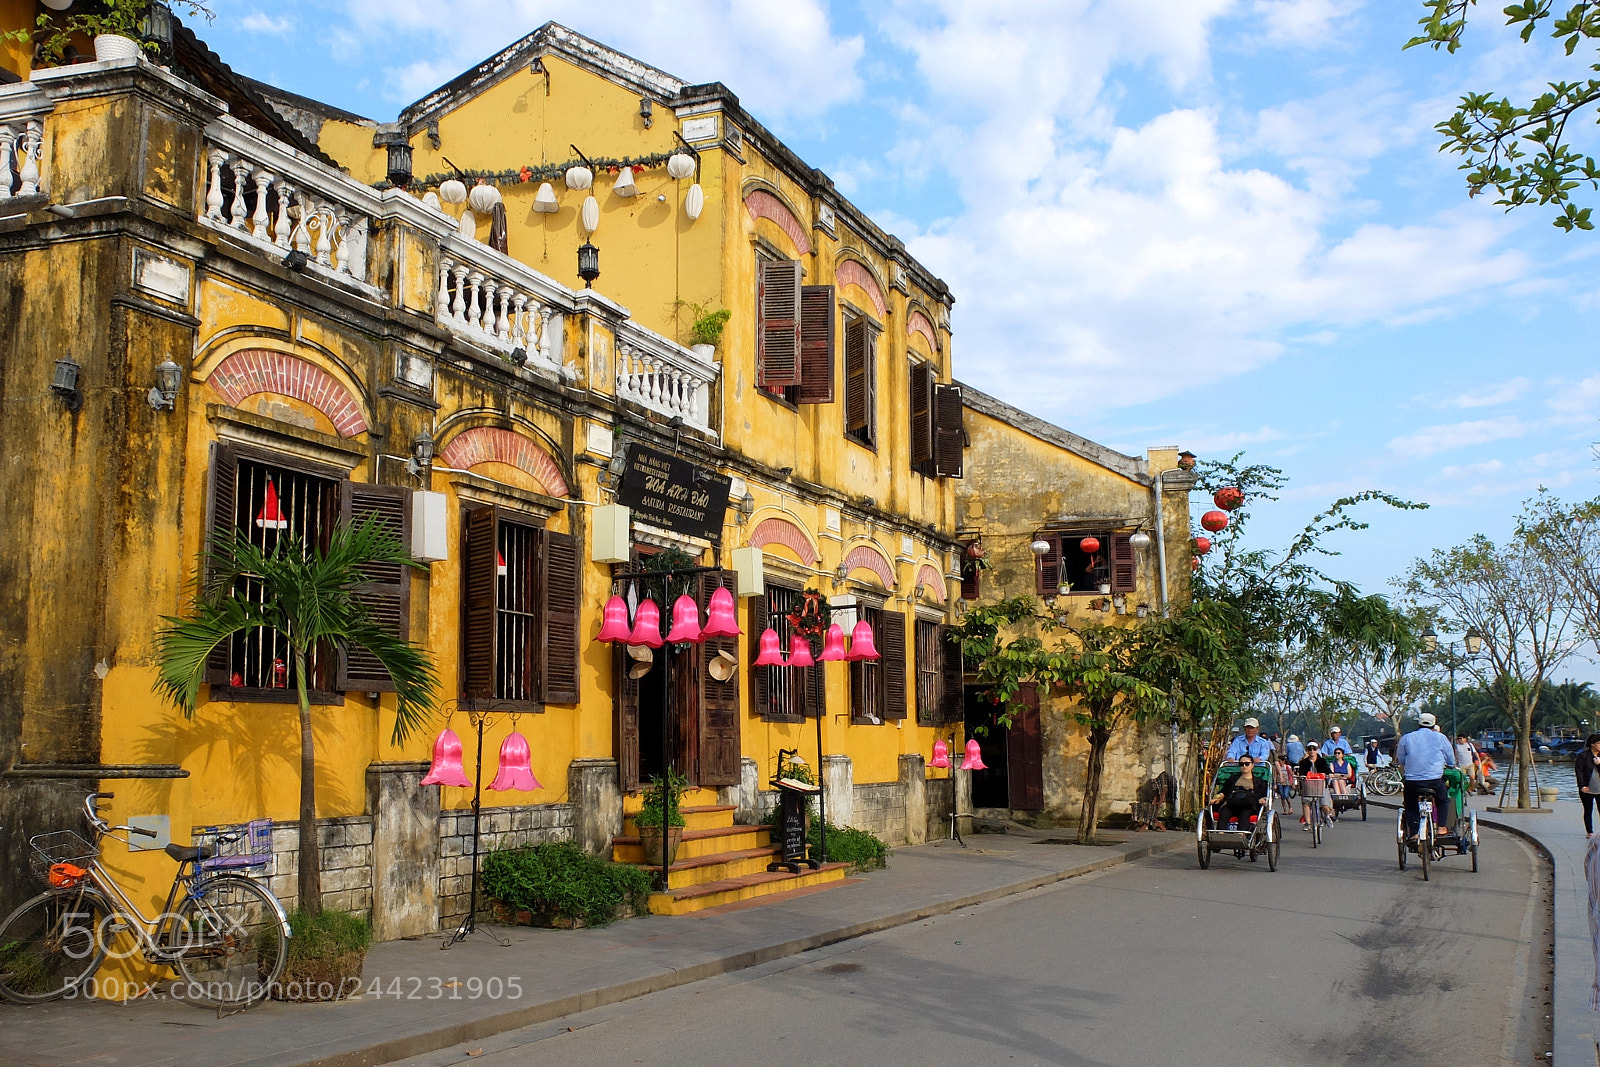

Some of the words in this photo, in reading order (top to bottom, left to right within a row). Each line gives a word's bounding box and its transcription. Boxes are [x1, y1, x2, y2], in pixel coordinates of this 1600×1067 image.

[645, 475, 667, 494] HOA
[641, 496, 665, 511] SAKURA
[668, 503, 705, 521] RESTAURANT
